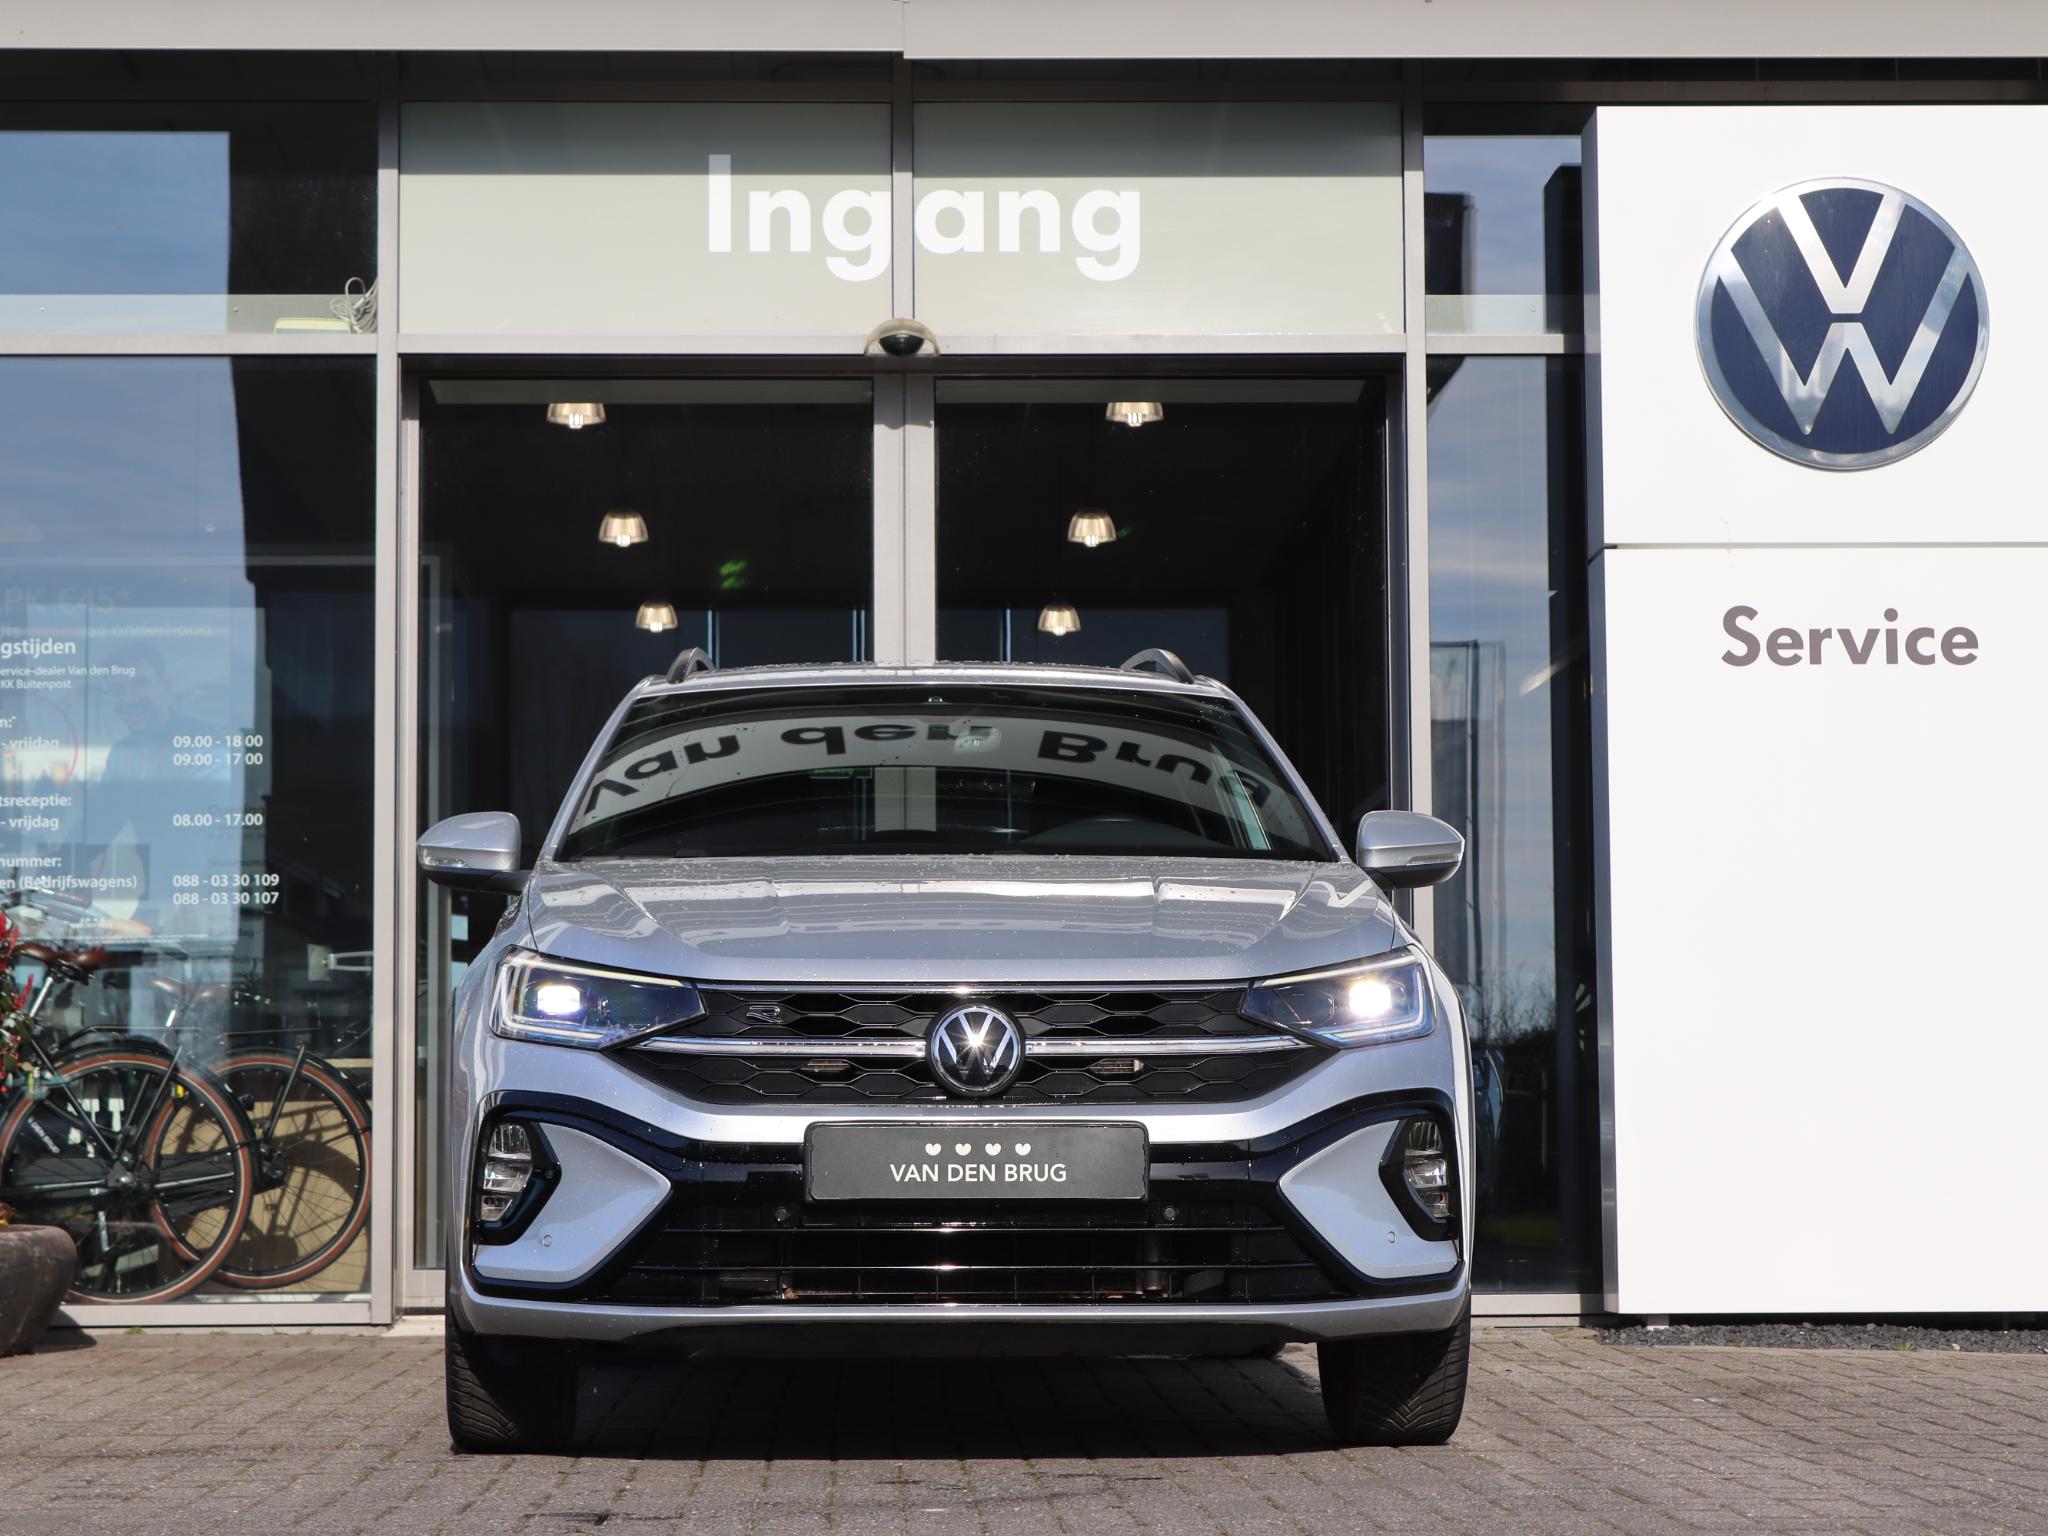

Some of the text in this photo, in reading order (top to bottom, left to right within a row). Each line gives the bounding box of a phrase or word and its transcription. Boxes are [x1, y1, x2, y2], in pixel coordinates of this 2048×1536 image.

[708, 154, 1141, 281] Ingang
[1720, 604, 1979, 667] Service
[0, 637, 77, 659] gstijden
[68, 665, 87, 675] Van
[89, 664, 109, 675] den
[111, 665, 136, 677] Brug
[1, 679, 72, 691] KK Buitenpost
[9, 736, 60, 750] vrijdag
[173, 735, 212, 748] 09.00
[173, 753, 212, 766] 09.00
[9, 815, 60, 831] vrijdag
[173, 814, 212, 827] 08.00
[225, 813, 263, 826] 17.00
[0, 856, 62, 867] nummer:
[0, 877, 16, 888] en
[19, 875, 137, 890] (Bedrijfswagens)
[173, 874, 199, 887] 088
[211, 874, 229, 887] 03
[232, 874, 250, 887] 30
[254, 873, 279, 886] 109
[173, 892, 199, 905] 088
[211, 892, 229, 905] 03
[232, 892, 250, 905] 30
[254, 891, 279, 904] 107
[890, 1163, 1067, 1182] VAN DEN BRUG
